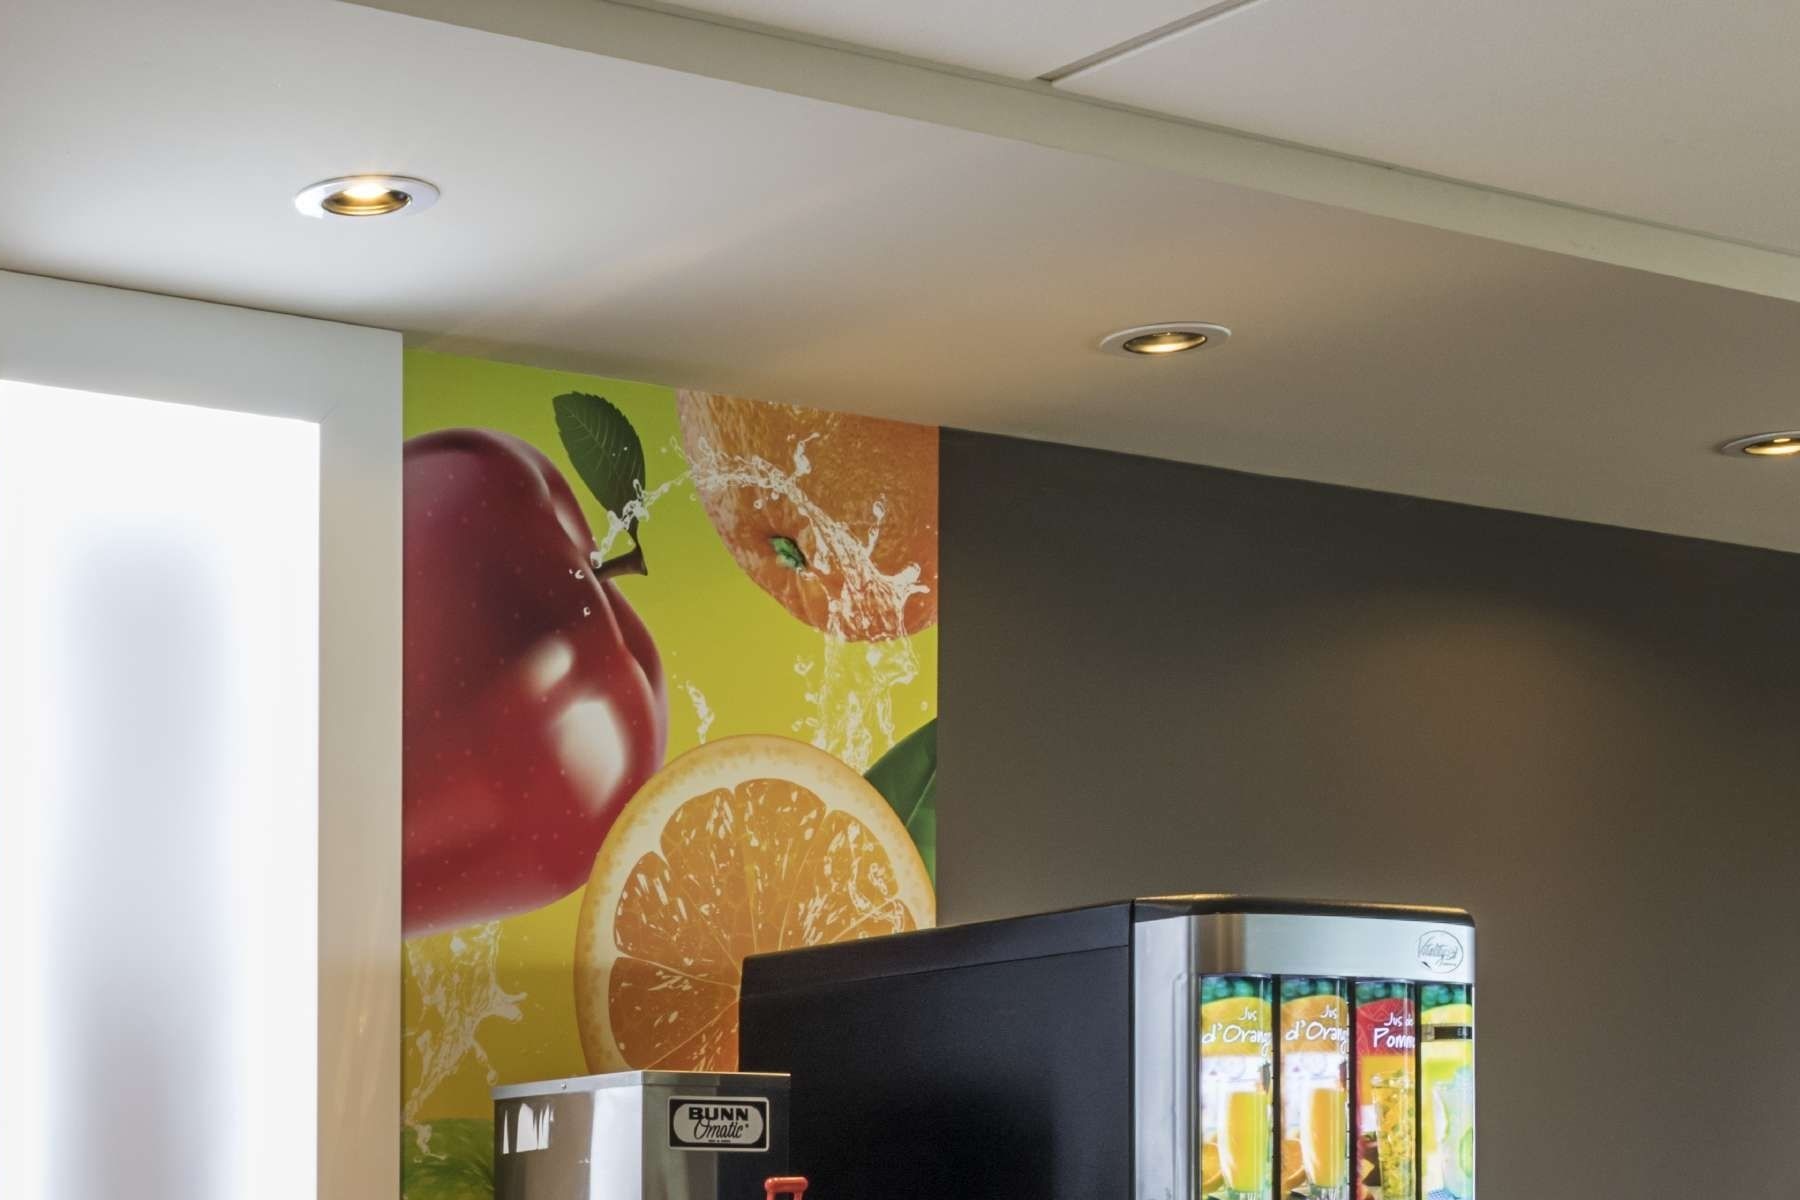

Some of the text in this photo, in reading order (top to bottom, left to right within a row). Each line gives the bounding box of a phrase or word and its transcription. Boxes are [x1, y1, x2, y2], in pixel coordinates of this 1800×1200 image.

[1238, 1007, 1257, 1021] Jus
[1321, 1004, 1337, 1019] Jus
[1383, 1012, 1402, 1028] Jus
[1201, 1022, 1273, 1057] d'Orang
[1285, 1021, 1350, 1055] d'Orang
[688, 1106, 749, 1121] BUNN
